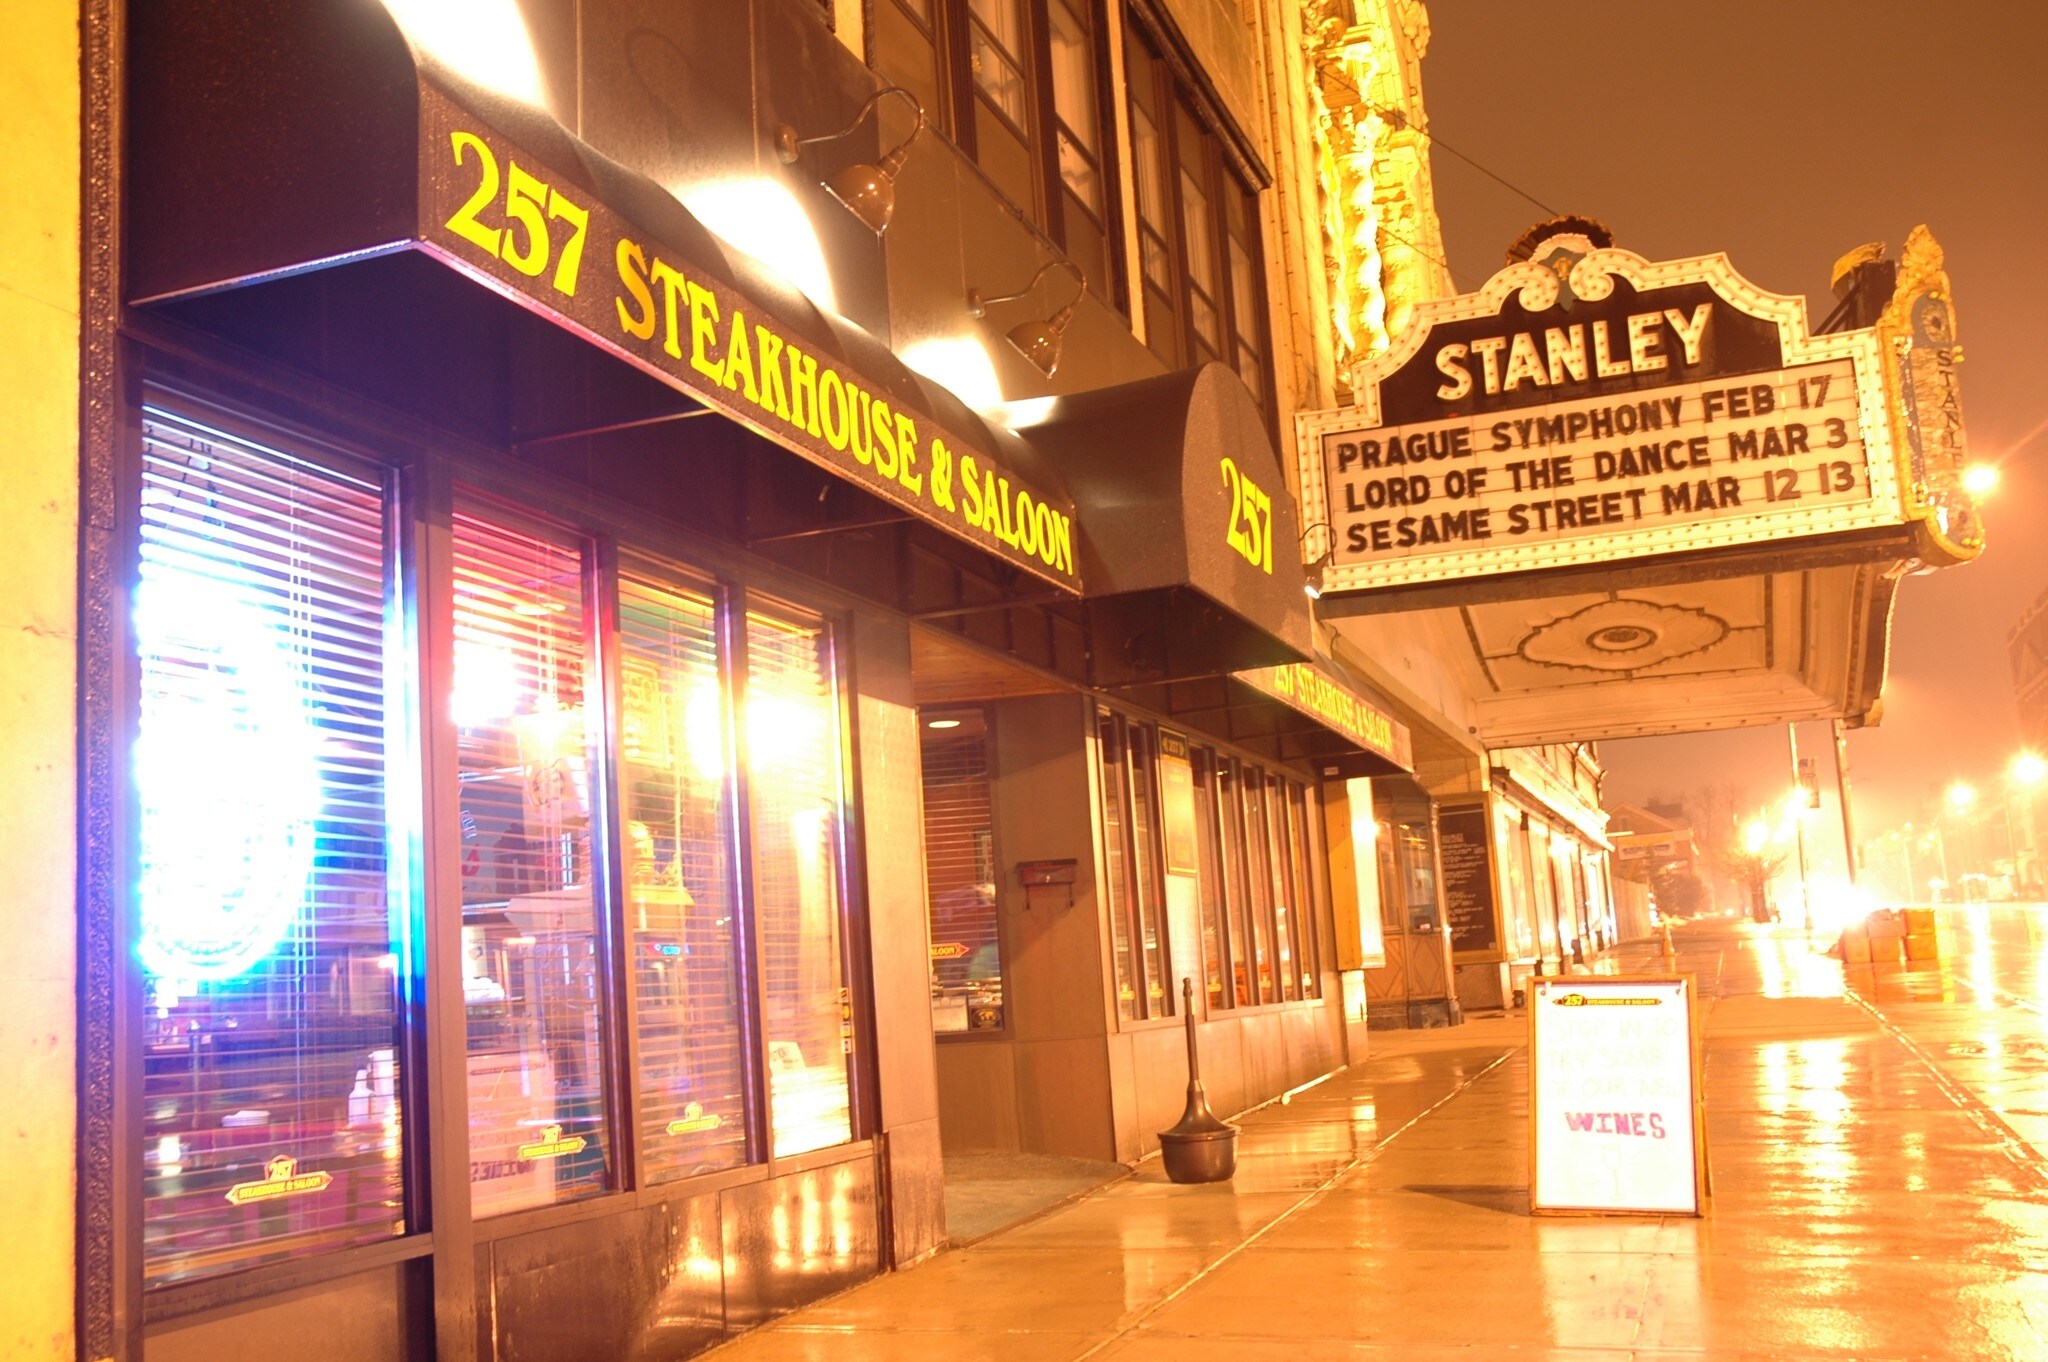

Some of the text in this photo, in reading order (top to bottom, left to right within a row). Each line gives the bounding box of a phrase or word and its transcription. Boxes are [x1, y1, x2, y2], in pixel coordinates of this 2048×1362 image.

[445, 132, 1073, 576] 257 STEAKHOUSE & SALOON
[1436, 304, 1713, 400] STANLEY
[1336, 375, 1832, 473] PRAGUE SYMPHONY FEB 17
[1344, 418, 1848, 512] LORD OF THE DANCE MAR 3
[1220, 457, 1272, 575] 257
[1345, 461, 1856, 554] SESAME STREET MAR 12 13
[1564, 994, 1583, 1006] 257
[1564, 1112, 1666, 1139] WINES
